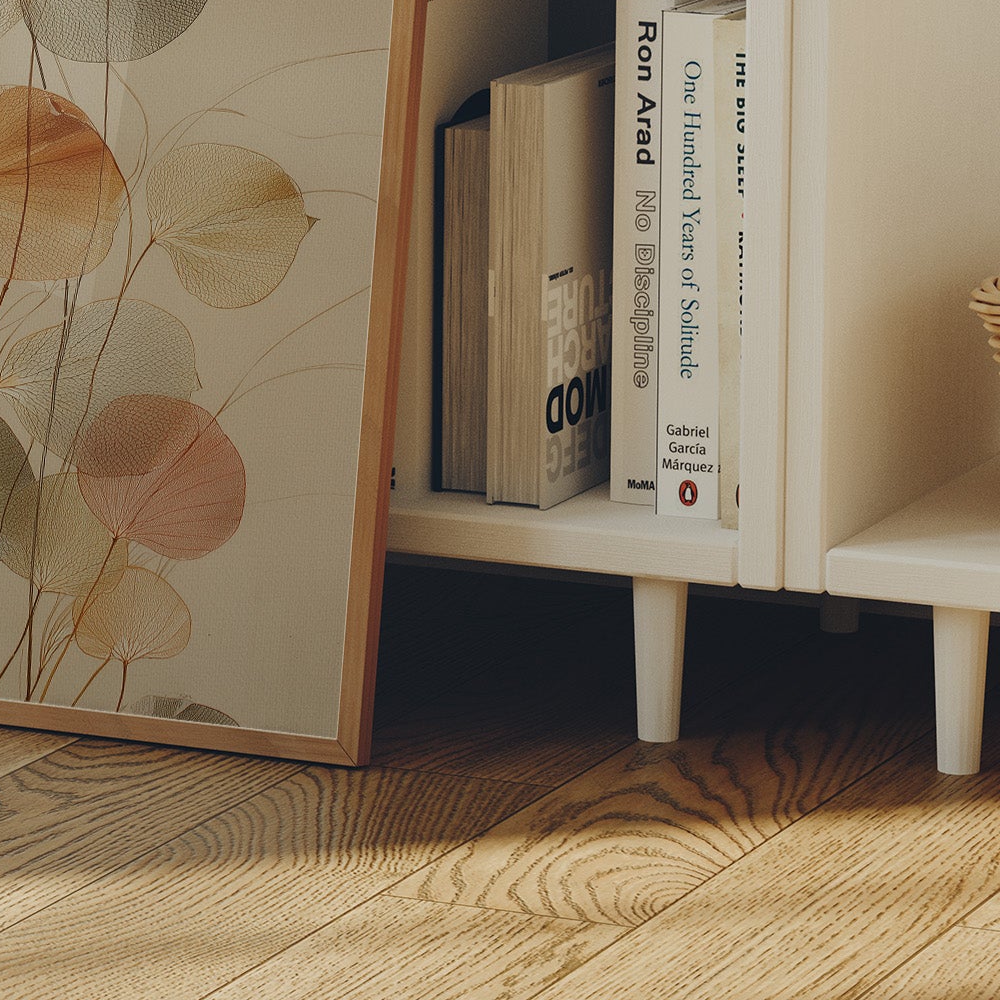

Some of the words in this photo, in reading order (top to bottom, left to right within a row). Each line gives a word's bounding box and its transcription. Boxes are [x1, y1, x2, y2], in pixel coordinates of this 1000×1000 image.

[637, 21, 657, 82] Ron
[684, 60, 702, 104] One
[636, 92, 657, 165] Arad
[682, 112, 702, 201] Hundred
[635, 190, 656, 232] No
[681, 207, 701, 261] Years
[681, 268, 700, 292] of
[630, 243, 656, 389] Discipline
[680, 298, 700, 380] Solitude
[546, 364, 607, 434] MOD
[666, 424, 709, 438] Gabriel
[668, 441, 706, 455] García
[627, 479, 655, 490] MoMA
[662, 458, 714, 474] Márquez
